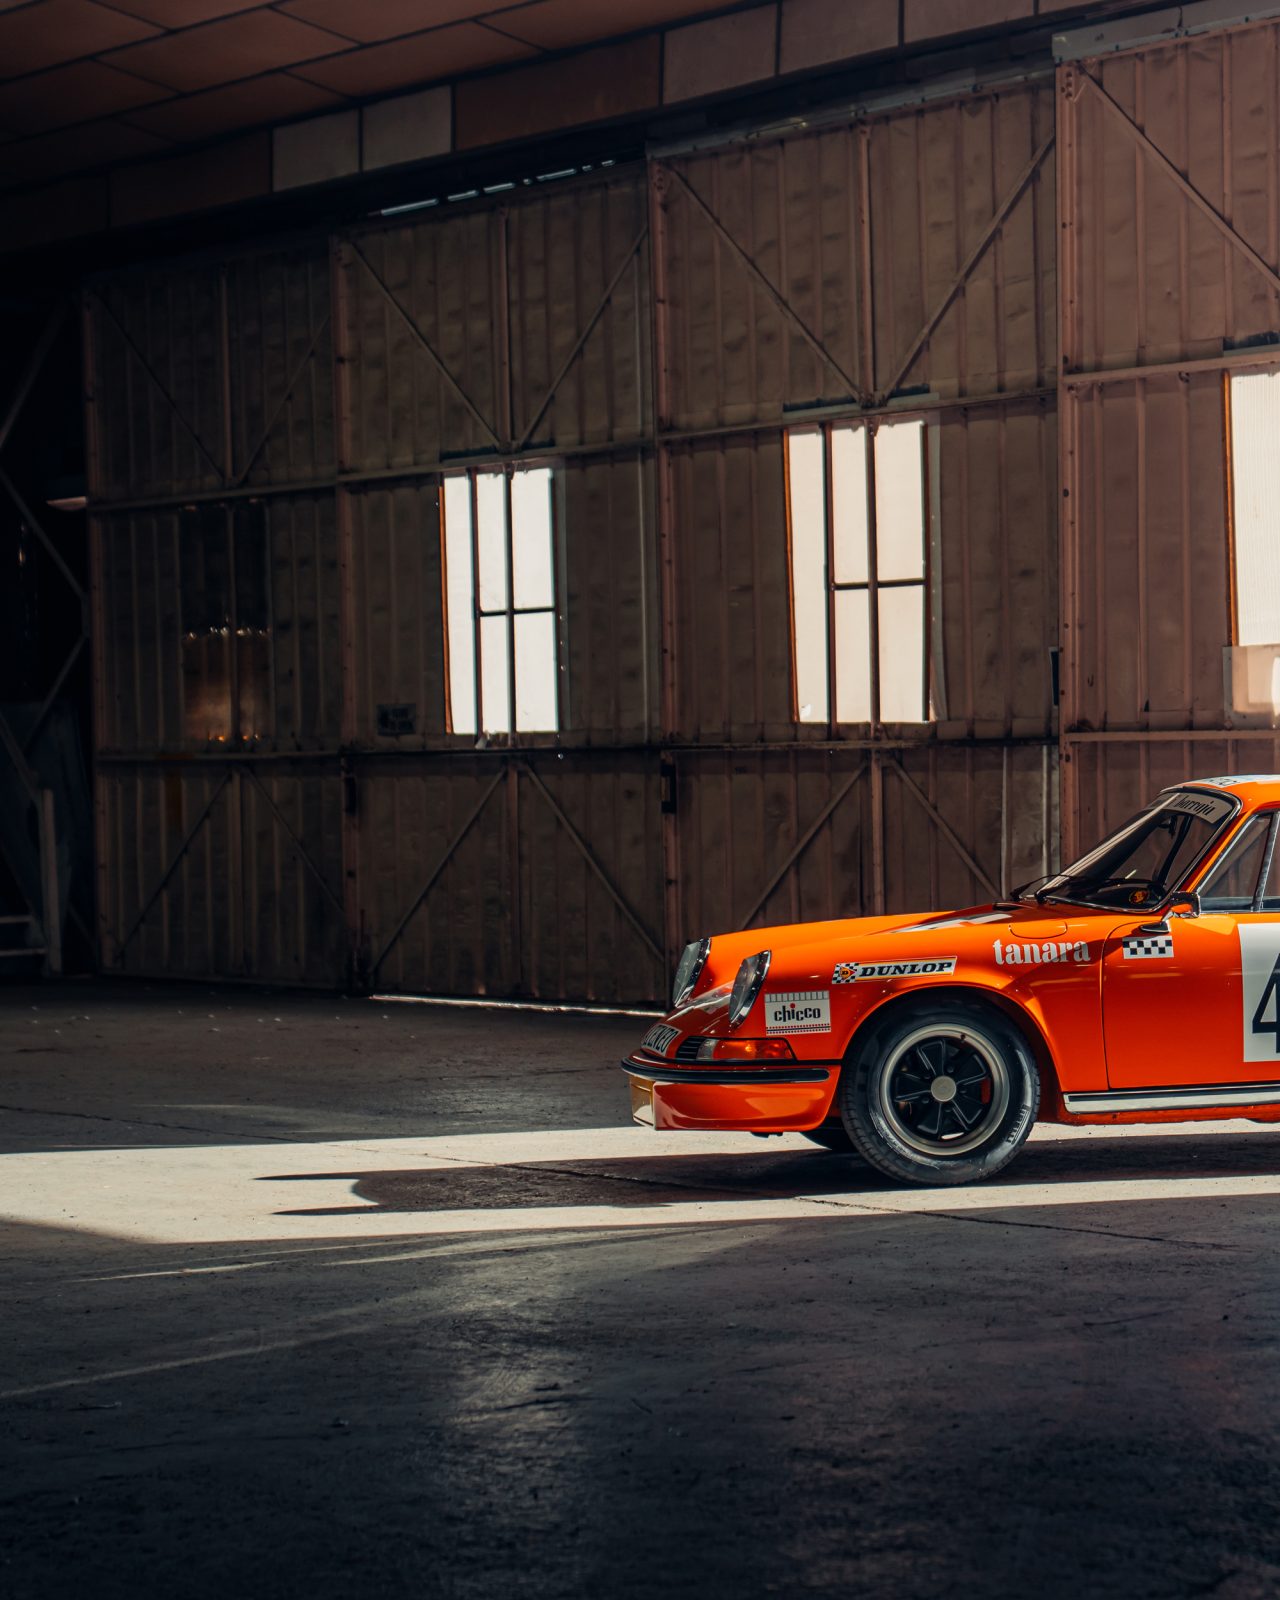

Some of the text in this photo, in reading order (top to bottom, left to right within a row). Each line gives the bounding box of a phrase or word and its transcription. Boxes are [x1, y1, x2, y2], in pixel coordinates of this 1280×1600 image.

[993, 939, 1091, 965] tanara
[859, 962, 952, 977] DUNLOP
[774, 1003, 821, 1022] chicco
